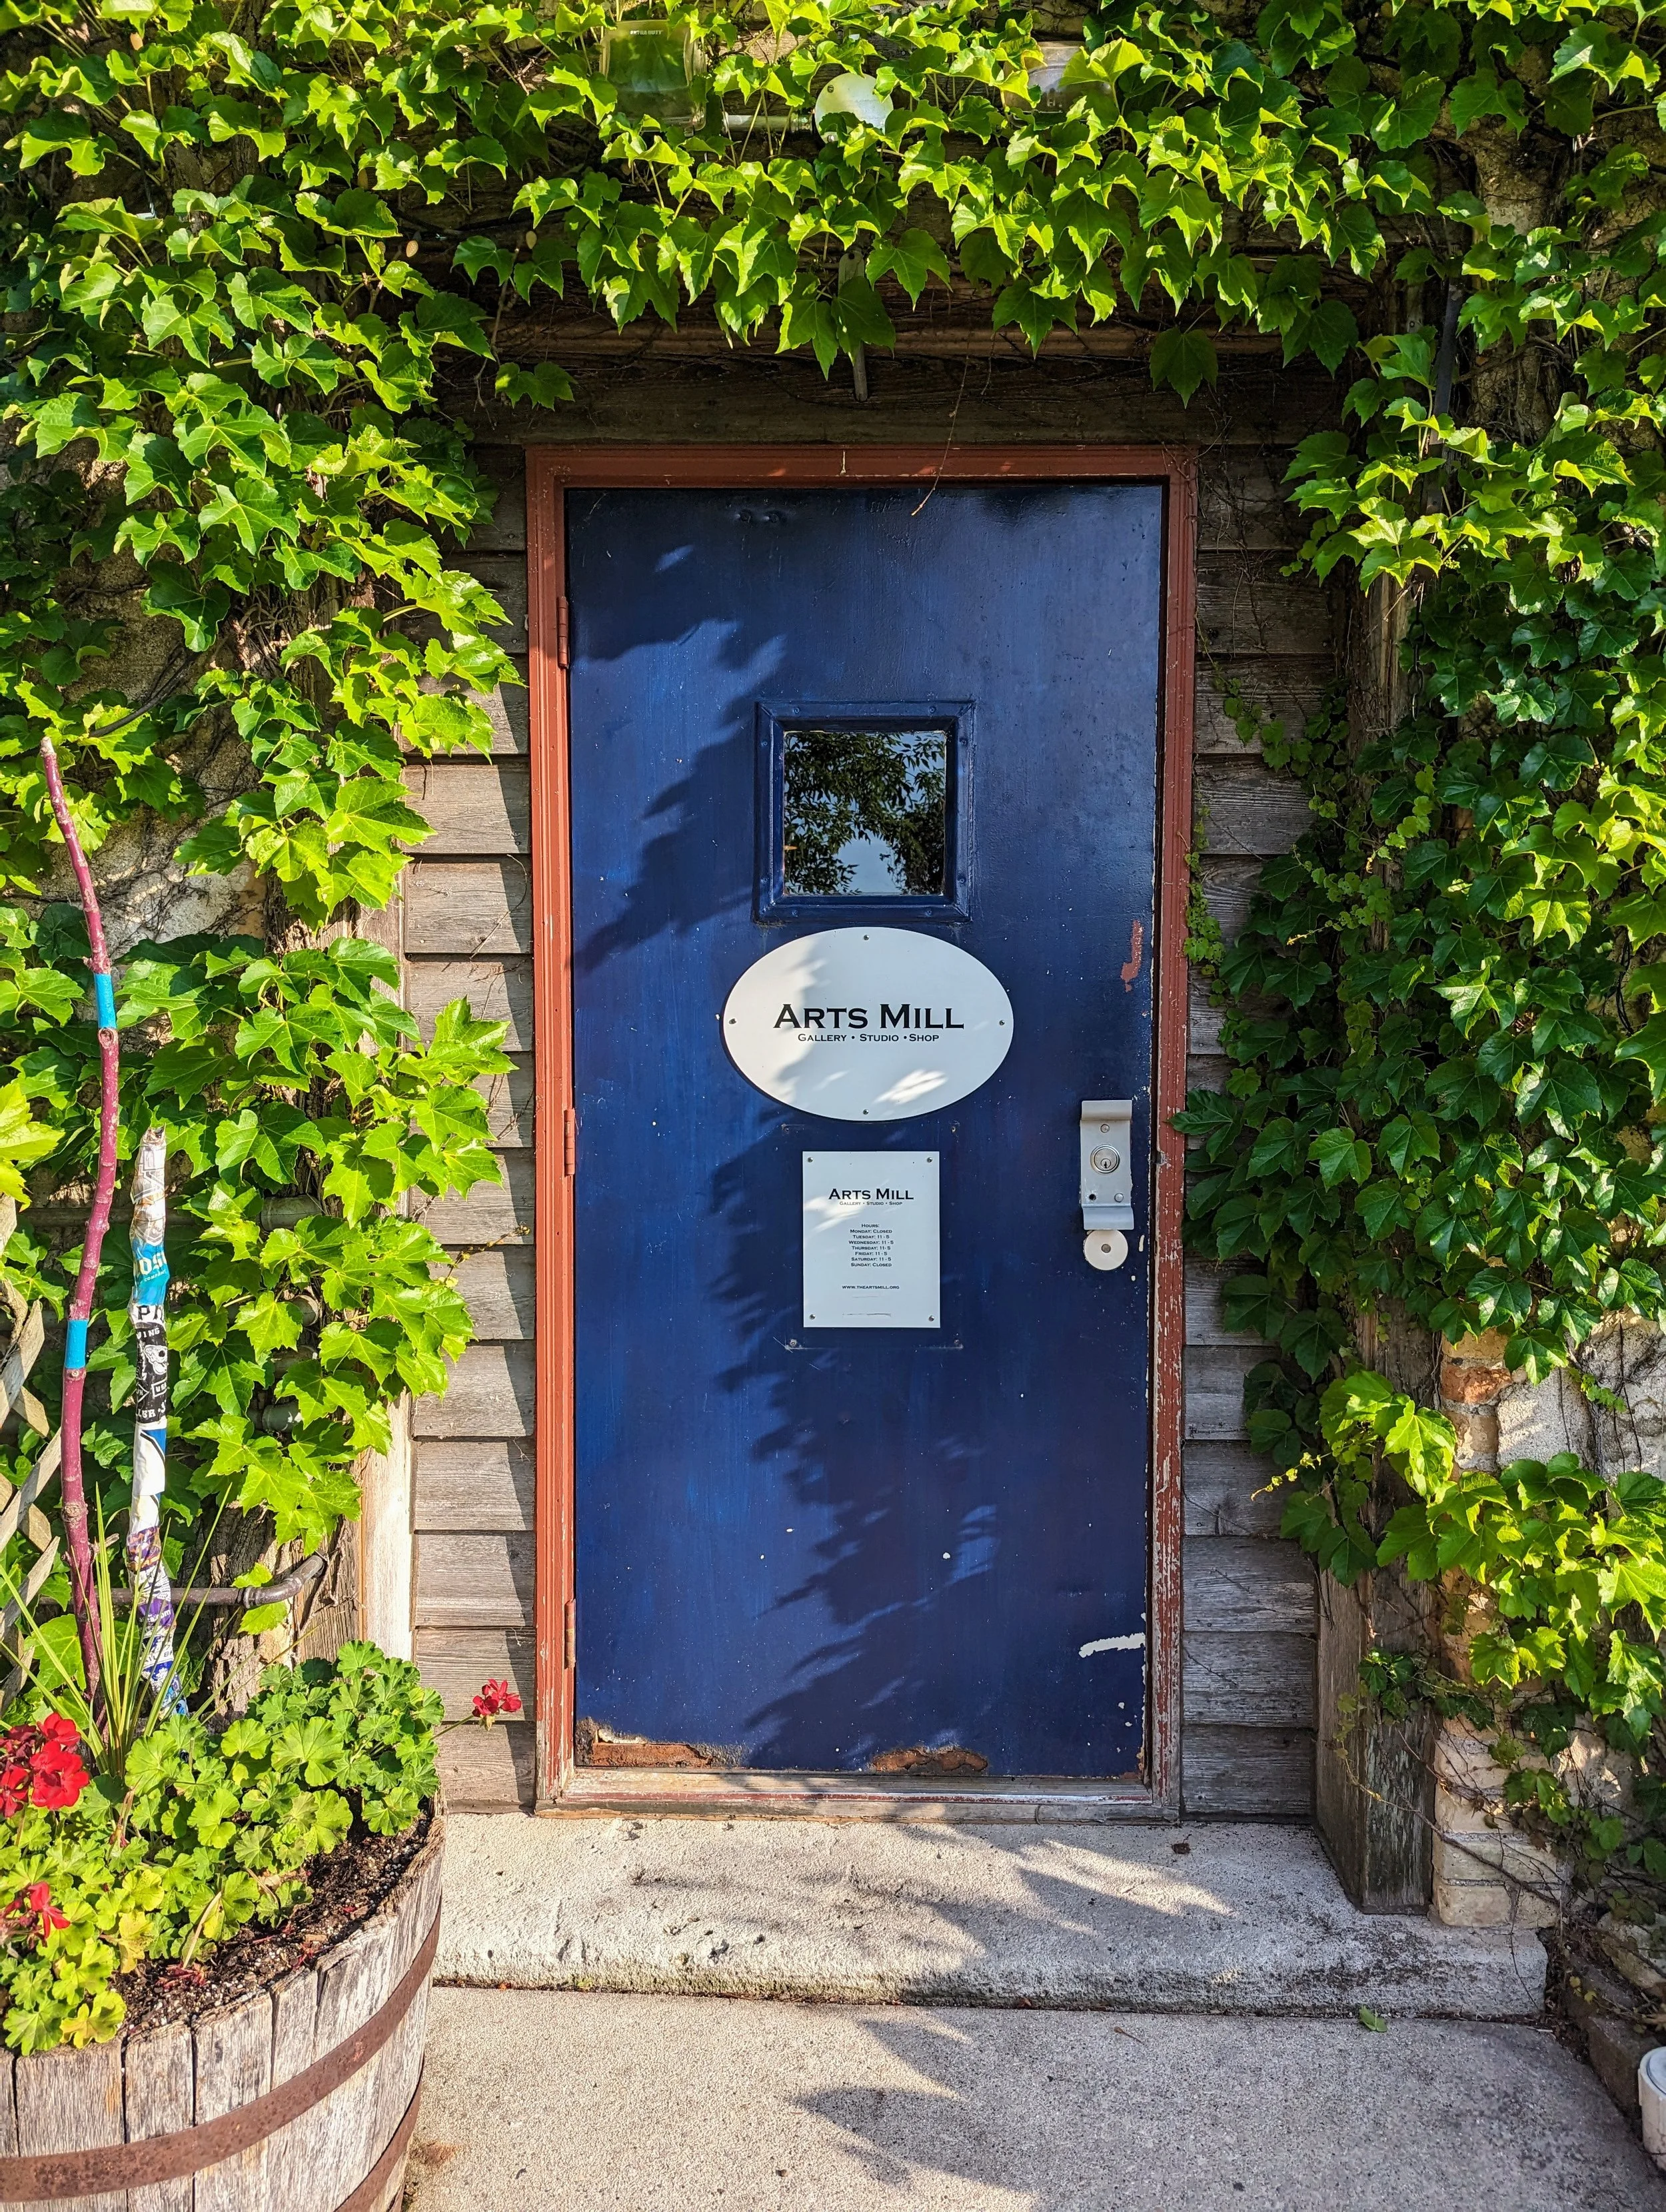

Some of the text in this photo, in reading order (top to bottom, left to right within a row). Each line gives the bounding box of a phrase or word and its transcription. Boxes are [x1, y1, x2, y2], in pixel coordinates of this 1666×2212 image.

[773, 1003, 964, 1029] ARTS MILL
[798, 1033, 847, 1042] GALLERY
[860, 1033, 899, 1042] STUDIO
[828, 1188, 914, 1200] ARTS MILL
